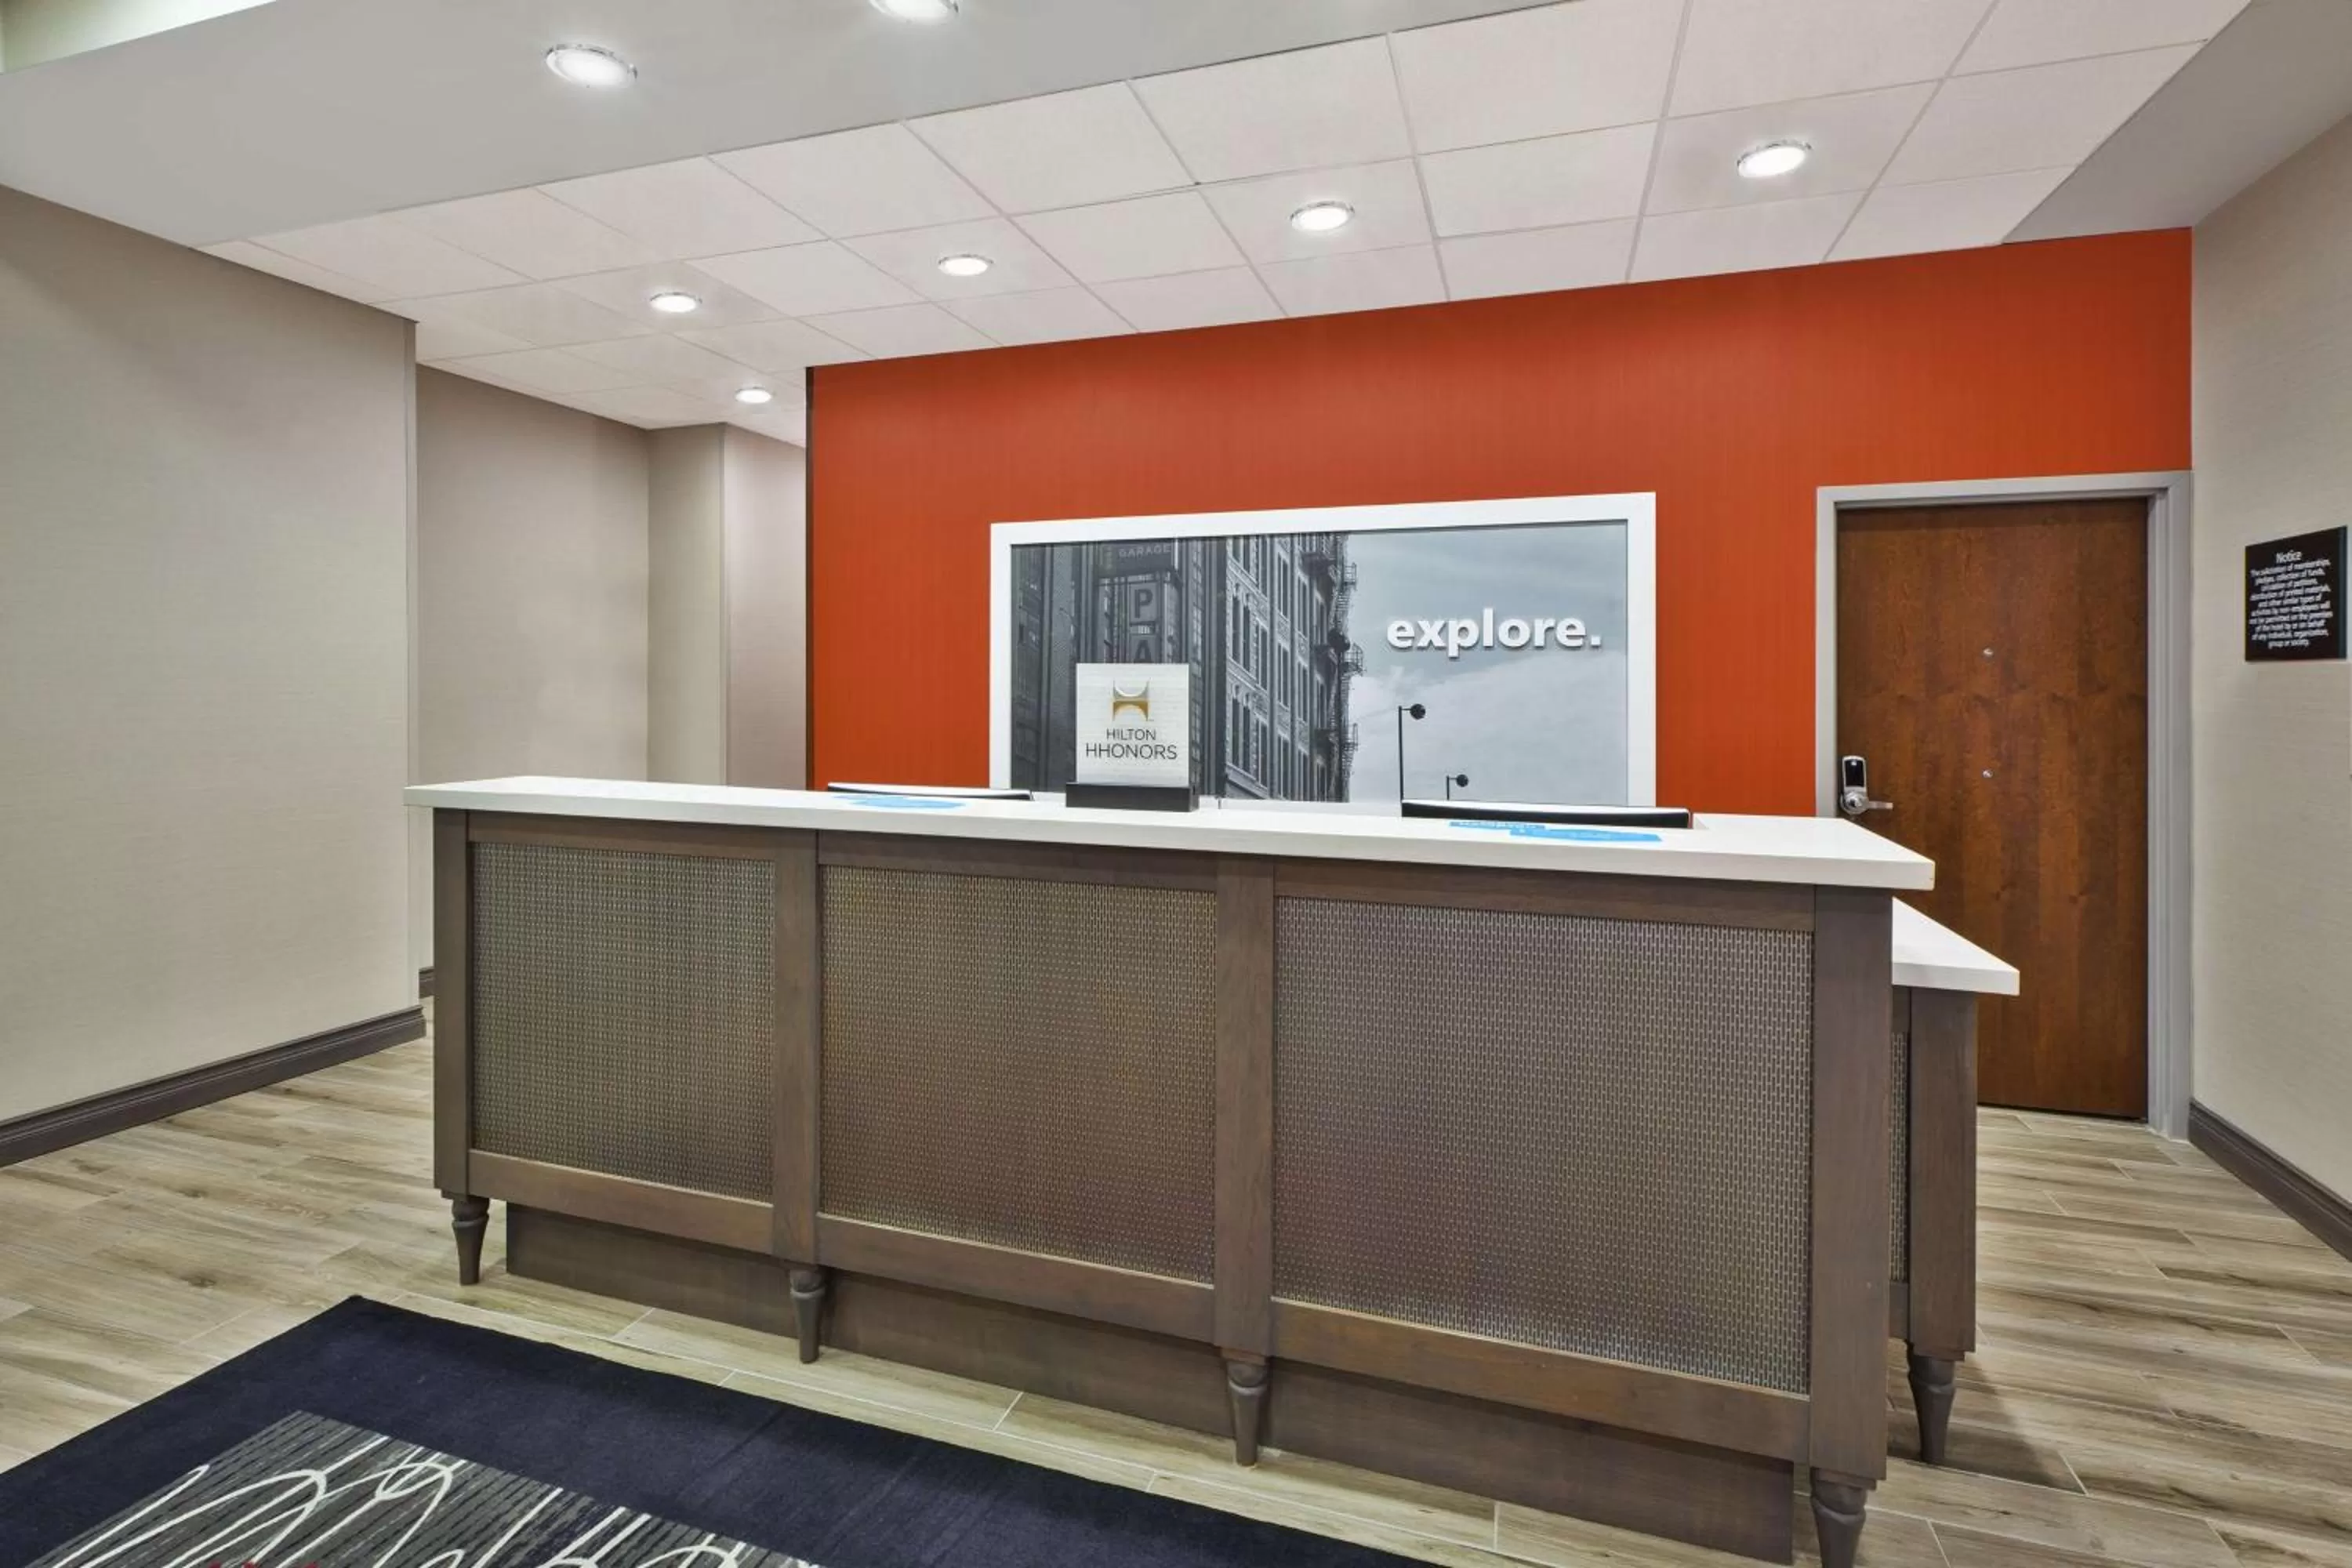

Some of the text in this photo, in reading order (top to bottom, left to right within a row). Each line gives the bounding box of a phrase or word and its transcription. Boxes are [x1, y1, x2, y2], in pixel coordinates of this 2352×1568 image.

[2276, 550, 2303, 564] Notice
[1386, 608, 1602, 659] explore.
[1106, 728, 1156, 741] HILTON
[1086, 742, 1178, 760] HHONORS
